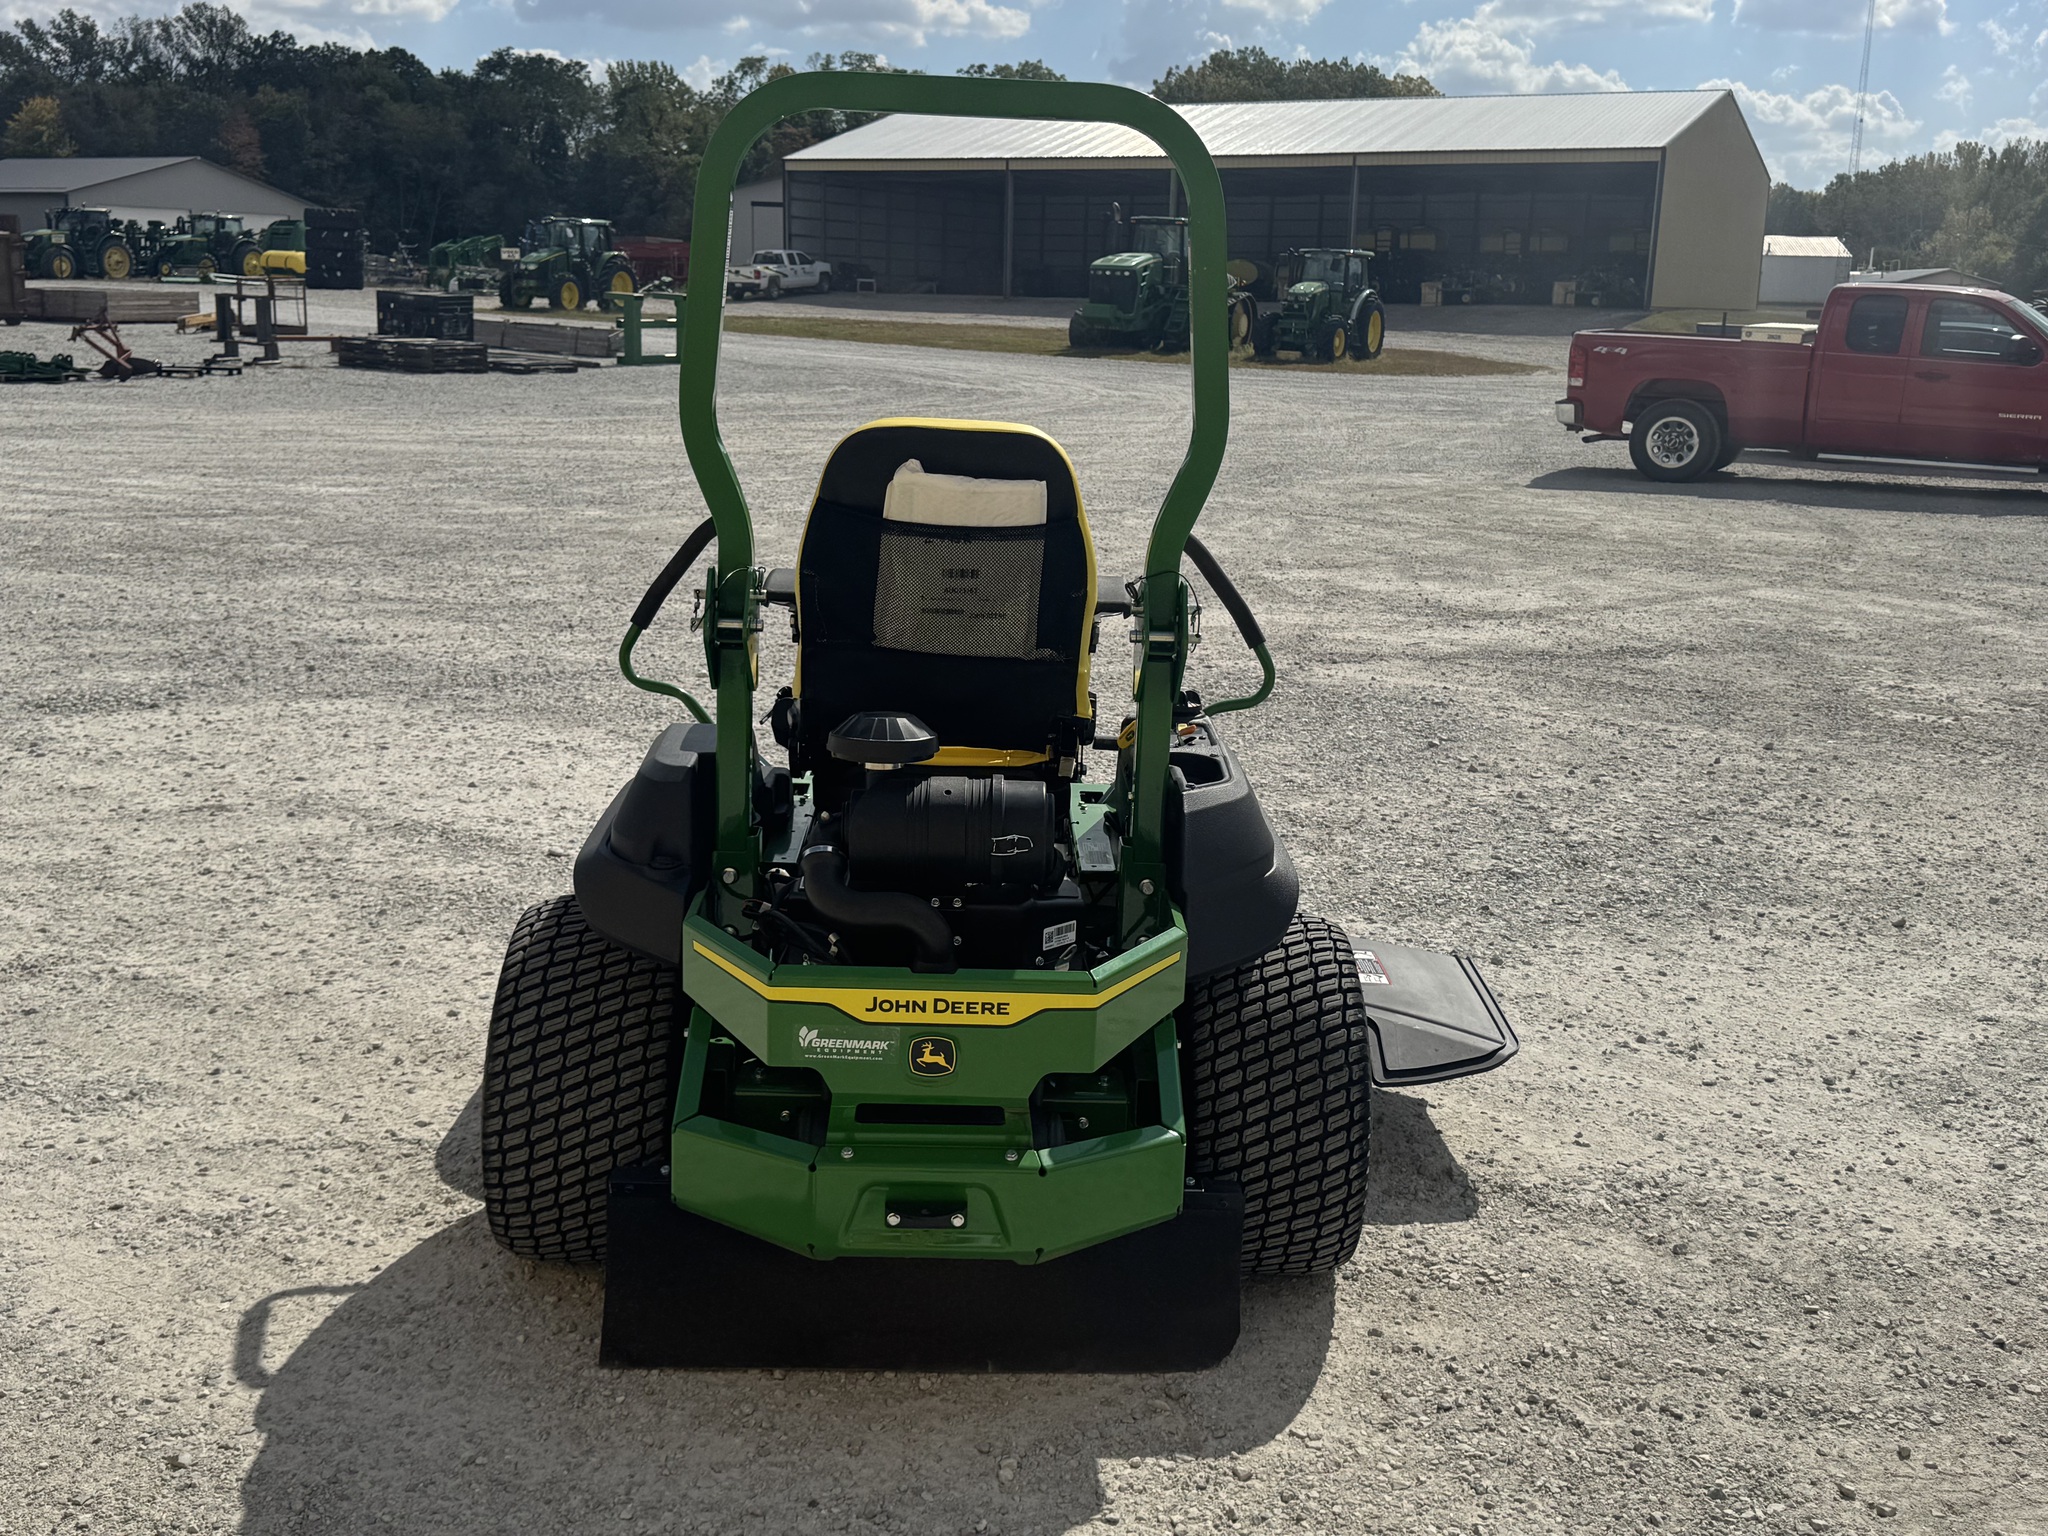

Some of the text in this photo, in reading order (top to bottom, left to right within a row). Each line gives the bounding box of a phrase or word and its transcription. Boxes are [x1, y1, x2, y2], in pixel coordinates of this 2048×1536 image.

[1998, 412, 2042, 420] SIERRA
[865, 996, 1010, 1016] JOHN DEERE
[811, 1038, 890, 1050] GREENMARK
[816, 1047, 883, 1055] EQUIPMENT
